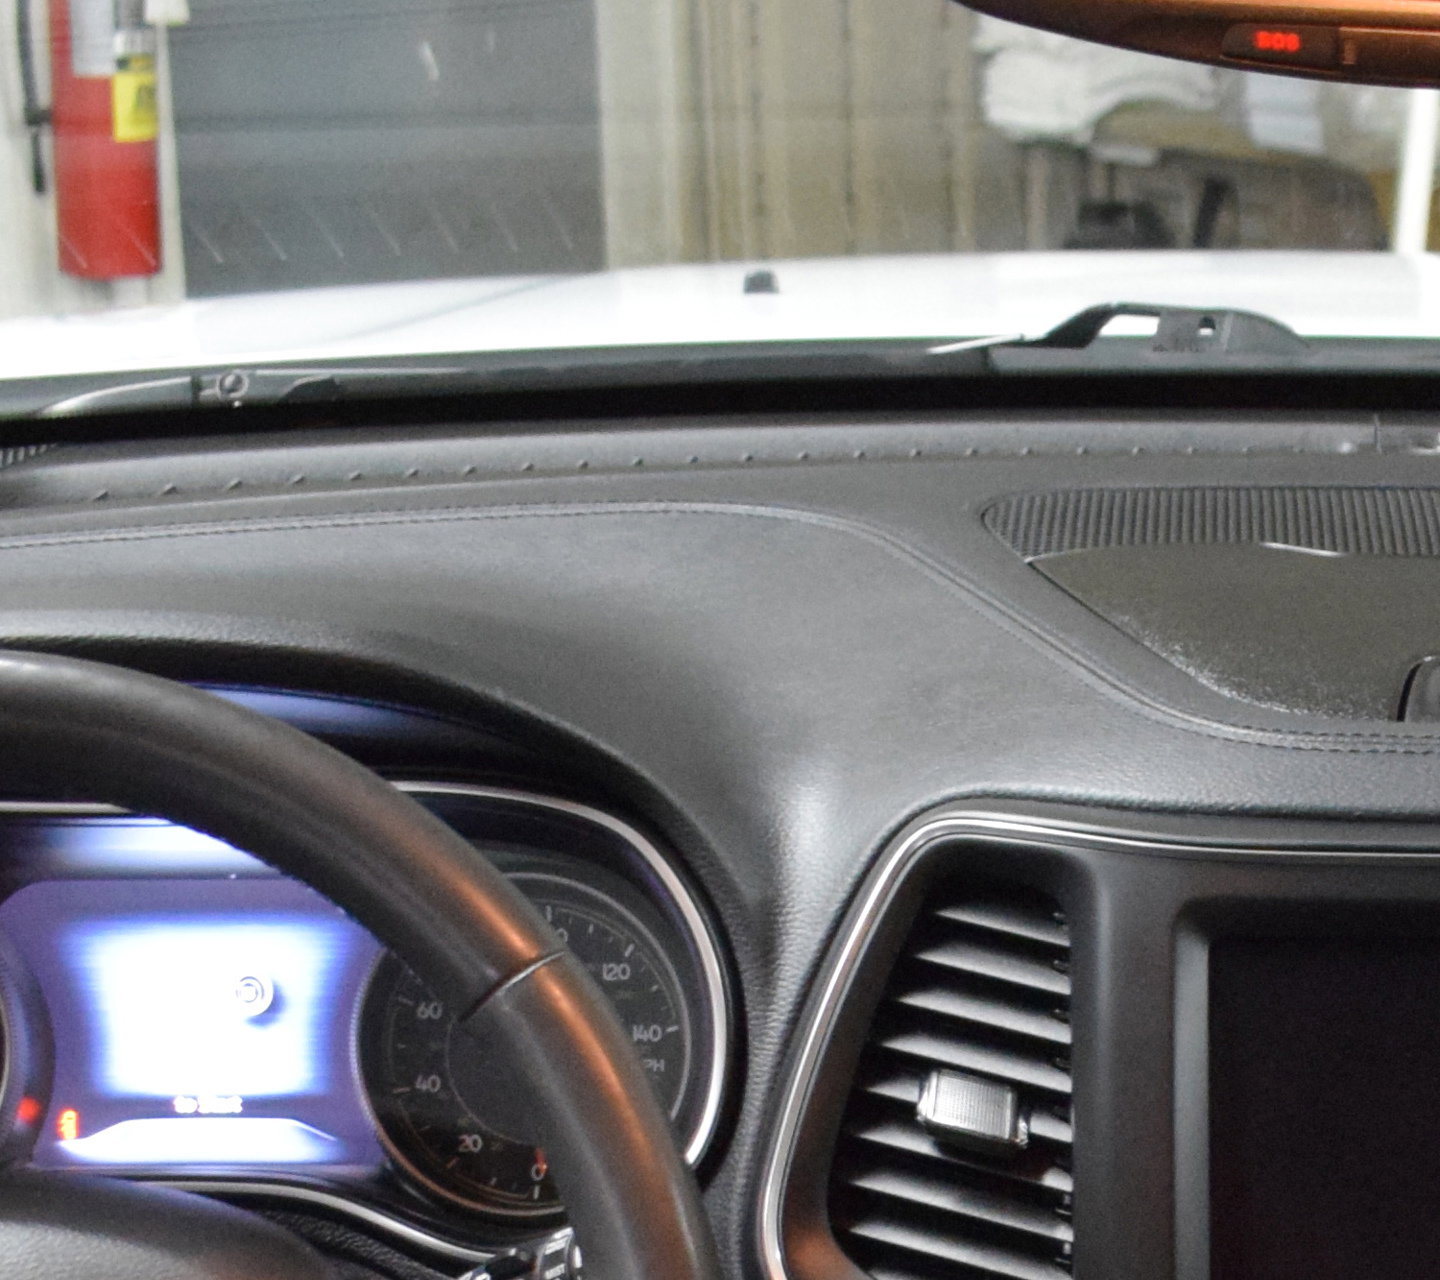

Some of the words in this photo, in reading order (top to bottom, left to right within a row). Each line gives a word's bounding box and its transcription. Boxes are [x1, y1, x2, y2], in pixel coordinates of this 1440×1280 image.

[602, 963, 631, 981] 120
[417, 1003, 442, 1019] 60
[633, 1025, 662, 1042] 140
[415, 1075, 441, 1092] 40
